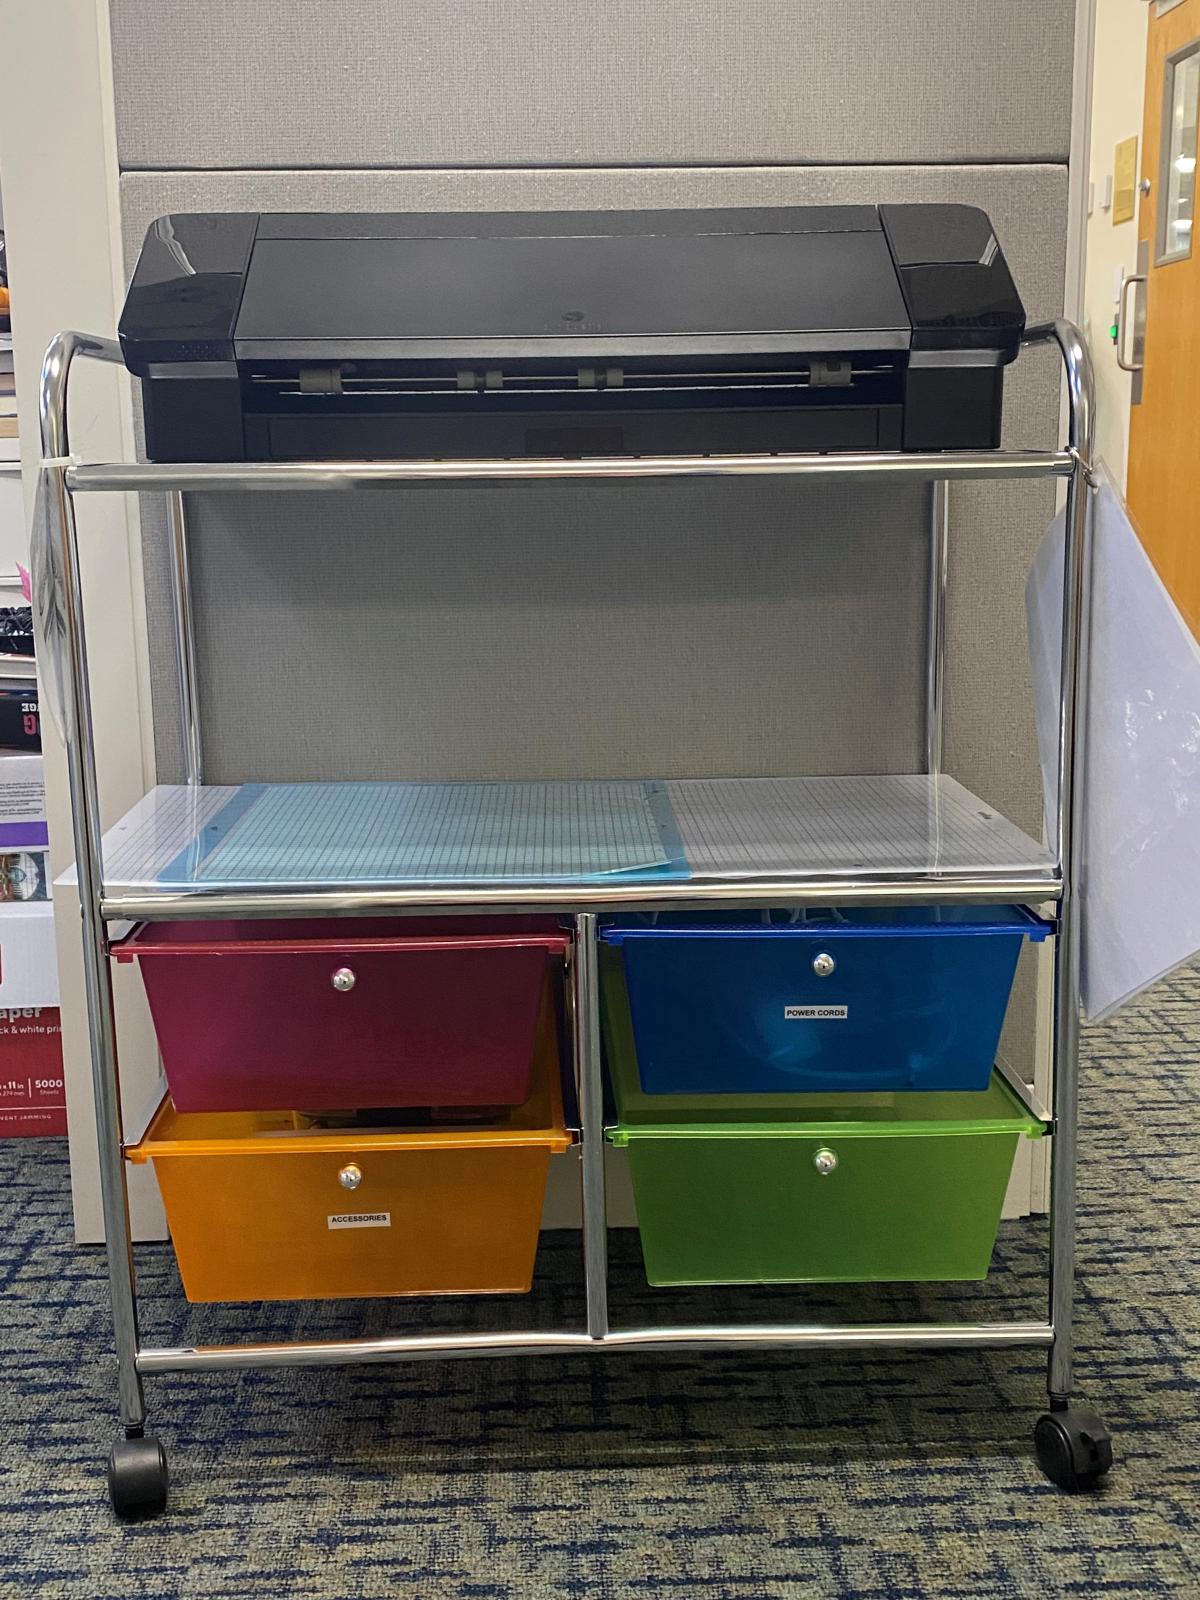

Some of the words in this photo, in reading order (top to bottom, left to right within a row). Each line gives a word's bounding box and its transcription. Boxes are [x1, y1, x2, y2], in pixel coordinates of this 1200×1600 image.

[786, 1009, 816, 1017] POWER
[817, 1009, 846, 1017] CORDS
[11, 1025, 18, 1034] &
[19, 1025, 45, 1034] white
[8, 1081, 16, 1089] 11
[35, 1079, 63, 1089] 5000
[331, 1214, 387, 1223] ACCESSORIES
